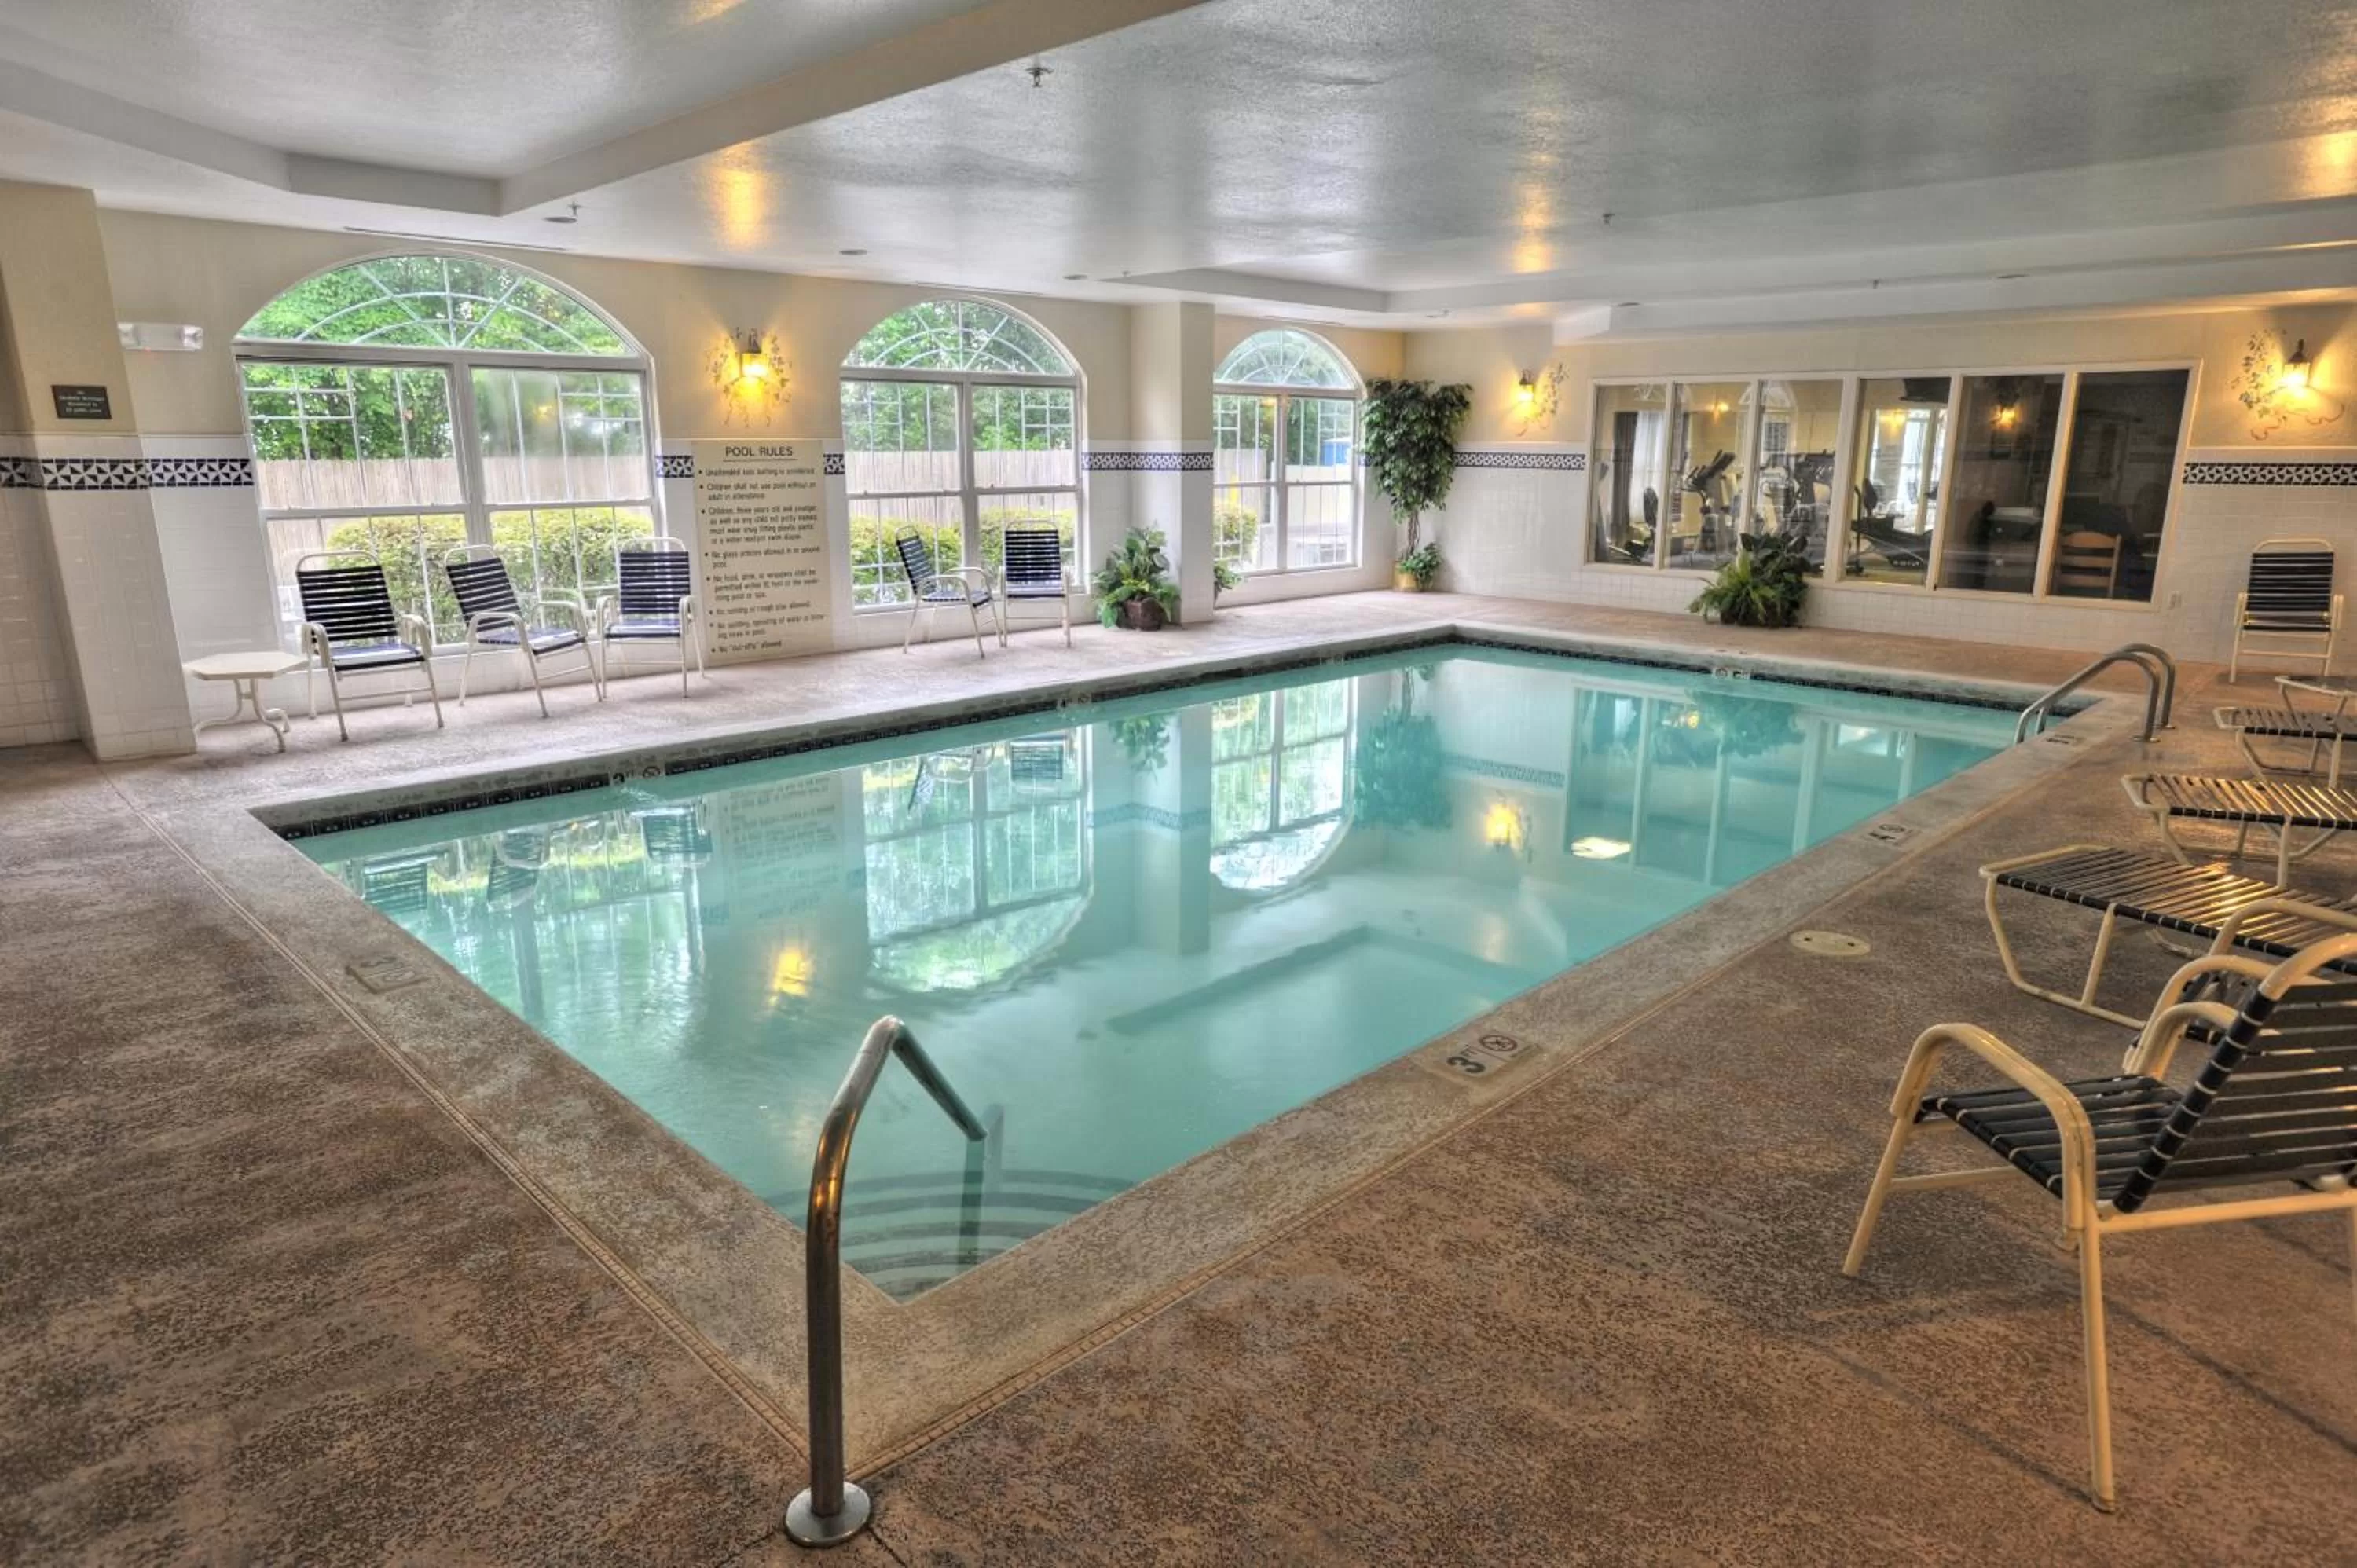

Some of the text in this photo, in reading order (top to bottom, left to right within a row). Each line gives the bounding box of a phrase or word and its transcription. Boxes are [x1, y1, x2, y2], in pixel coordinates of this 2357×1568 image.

[725, 446, 793, 456] POOL RULES
[1446, 1056, 1486, 1074] 3
